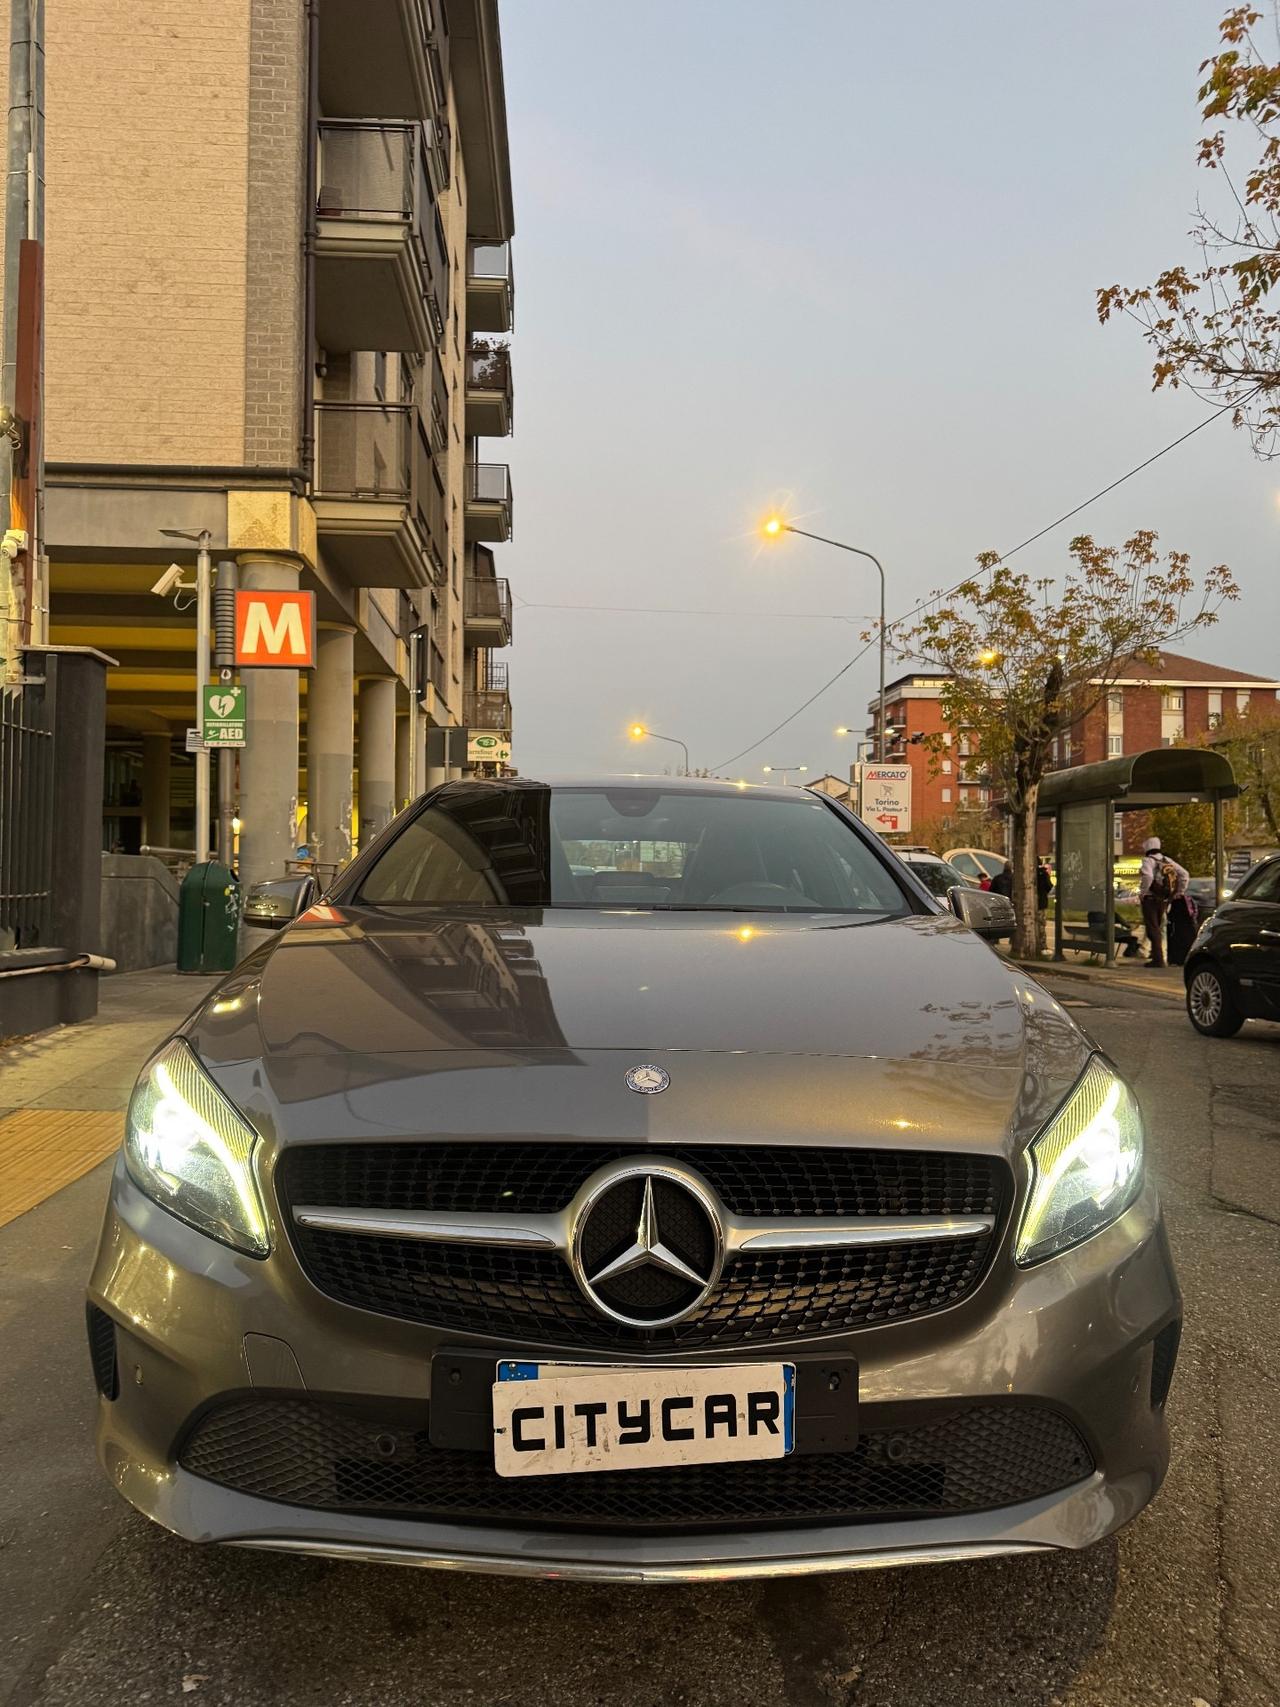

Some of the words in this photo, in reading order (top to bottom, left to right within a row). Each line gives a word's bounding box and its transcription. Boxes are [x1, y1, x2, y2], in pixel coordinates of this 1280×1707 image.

[241, 601, 307, 655] M
[219, 728, 243, 739] AED
[875, 798, 900, 806] Torino
[511, 1391, 780, 1452] CITYCAR
